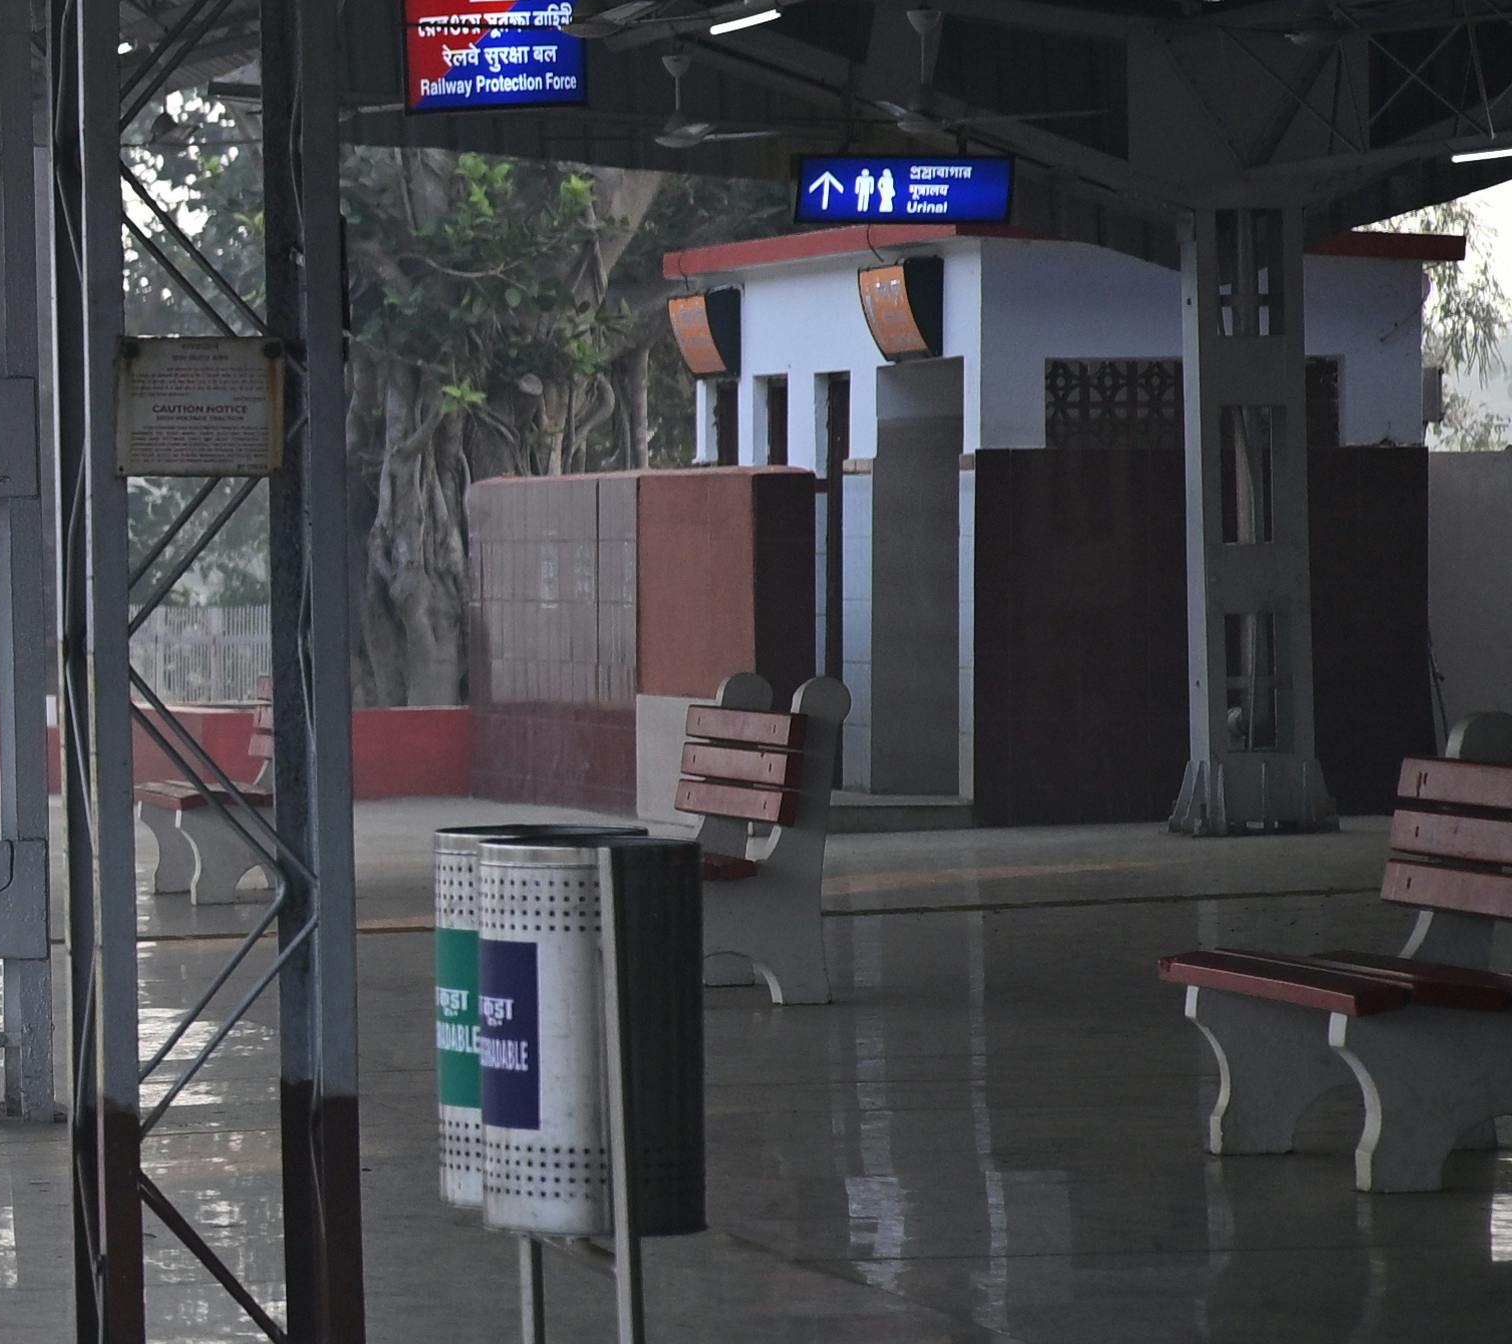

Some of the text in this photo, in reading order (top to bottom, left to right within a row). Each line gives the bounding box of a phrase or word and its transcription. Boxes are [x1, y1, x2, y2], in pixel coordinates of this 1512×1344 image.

[442, 43, 481, 67] रेलवे
[484, 45, 530, 72] सुरक्षा
[420, 72, 576, 98] Railway Protection Force
[906, 200, 948, 213] Urinal
[152, 404, 248, 414] CAUTION NOTICE
